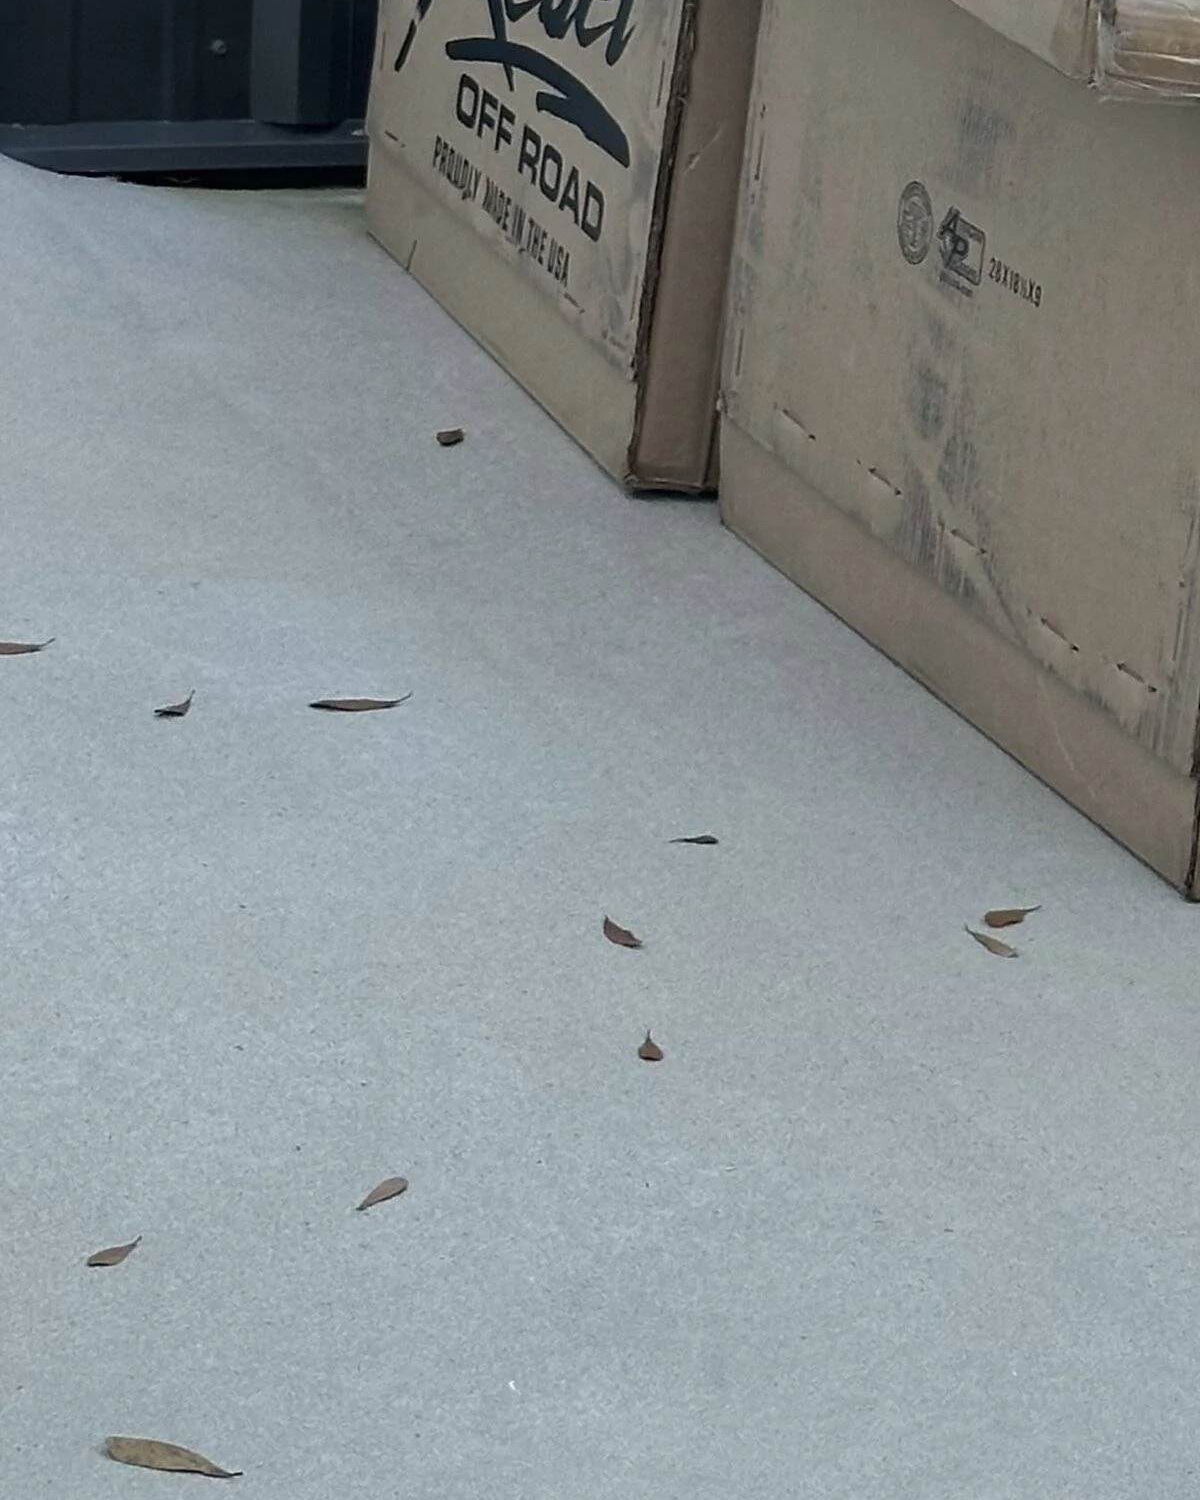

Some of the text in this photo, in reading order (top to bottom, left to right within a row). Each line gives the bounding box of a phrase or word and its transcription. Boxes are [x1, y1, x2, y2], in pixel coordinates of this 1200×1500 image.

[433, 135, 570, 288] PROUDLY MADE IN THE USA
[456, 73, 605, 243] OFF ROAD
